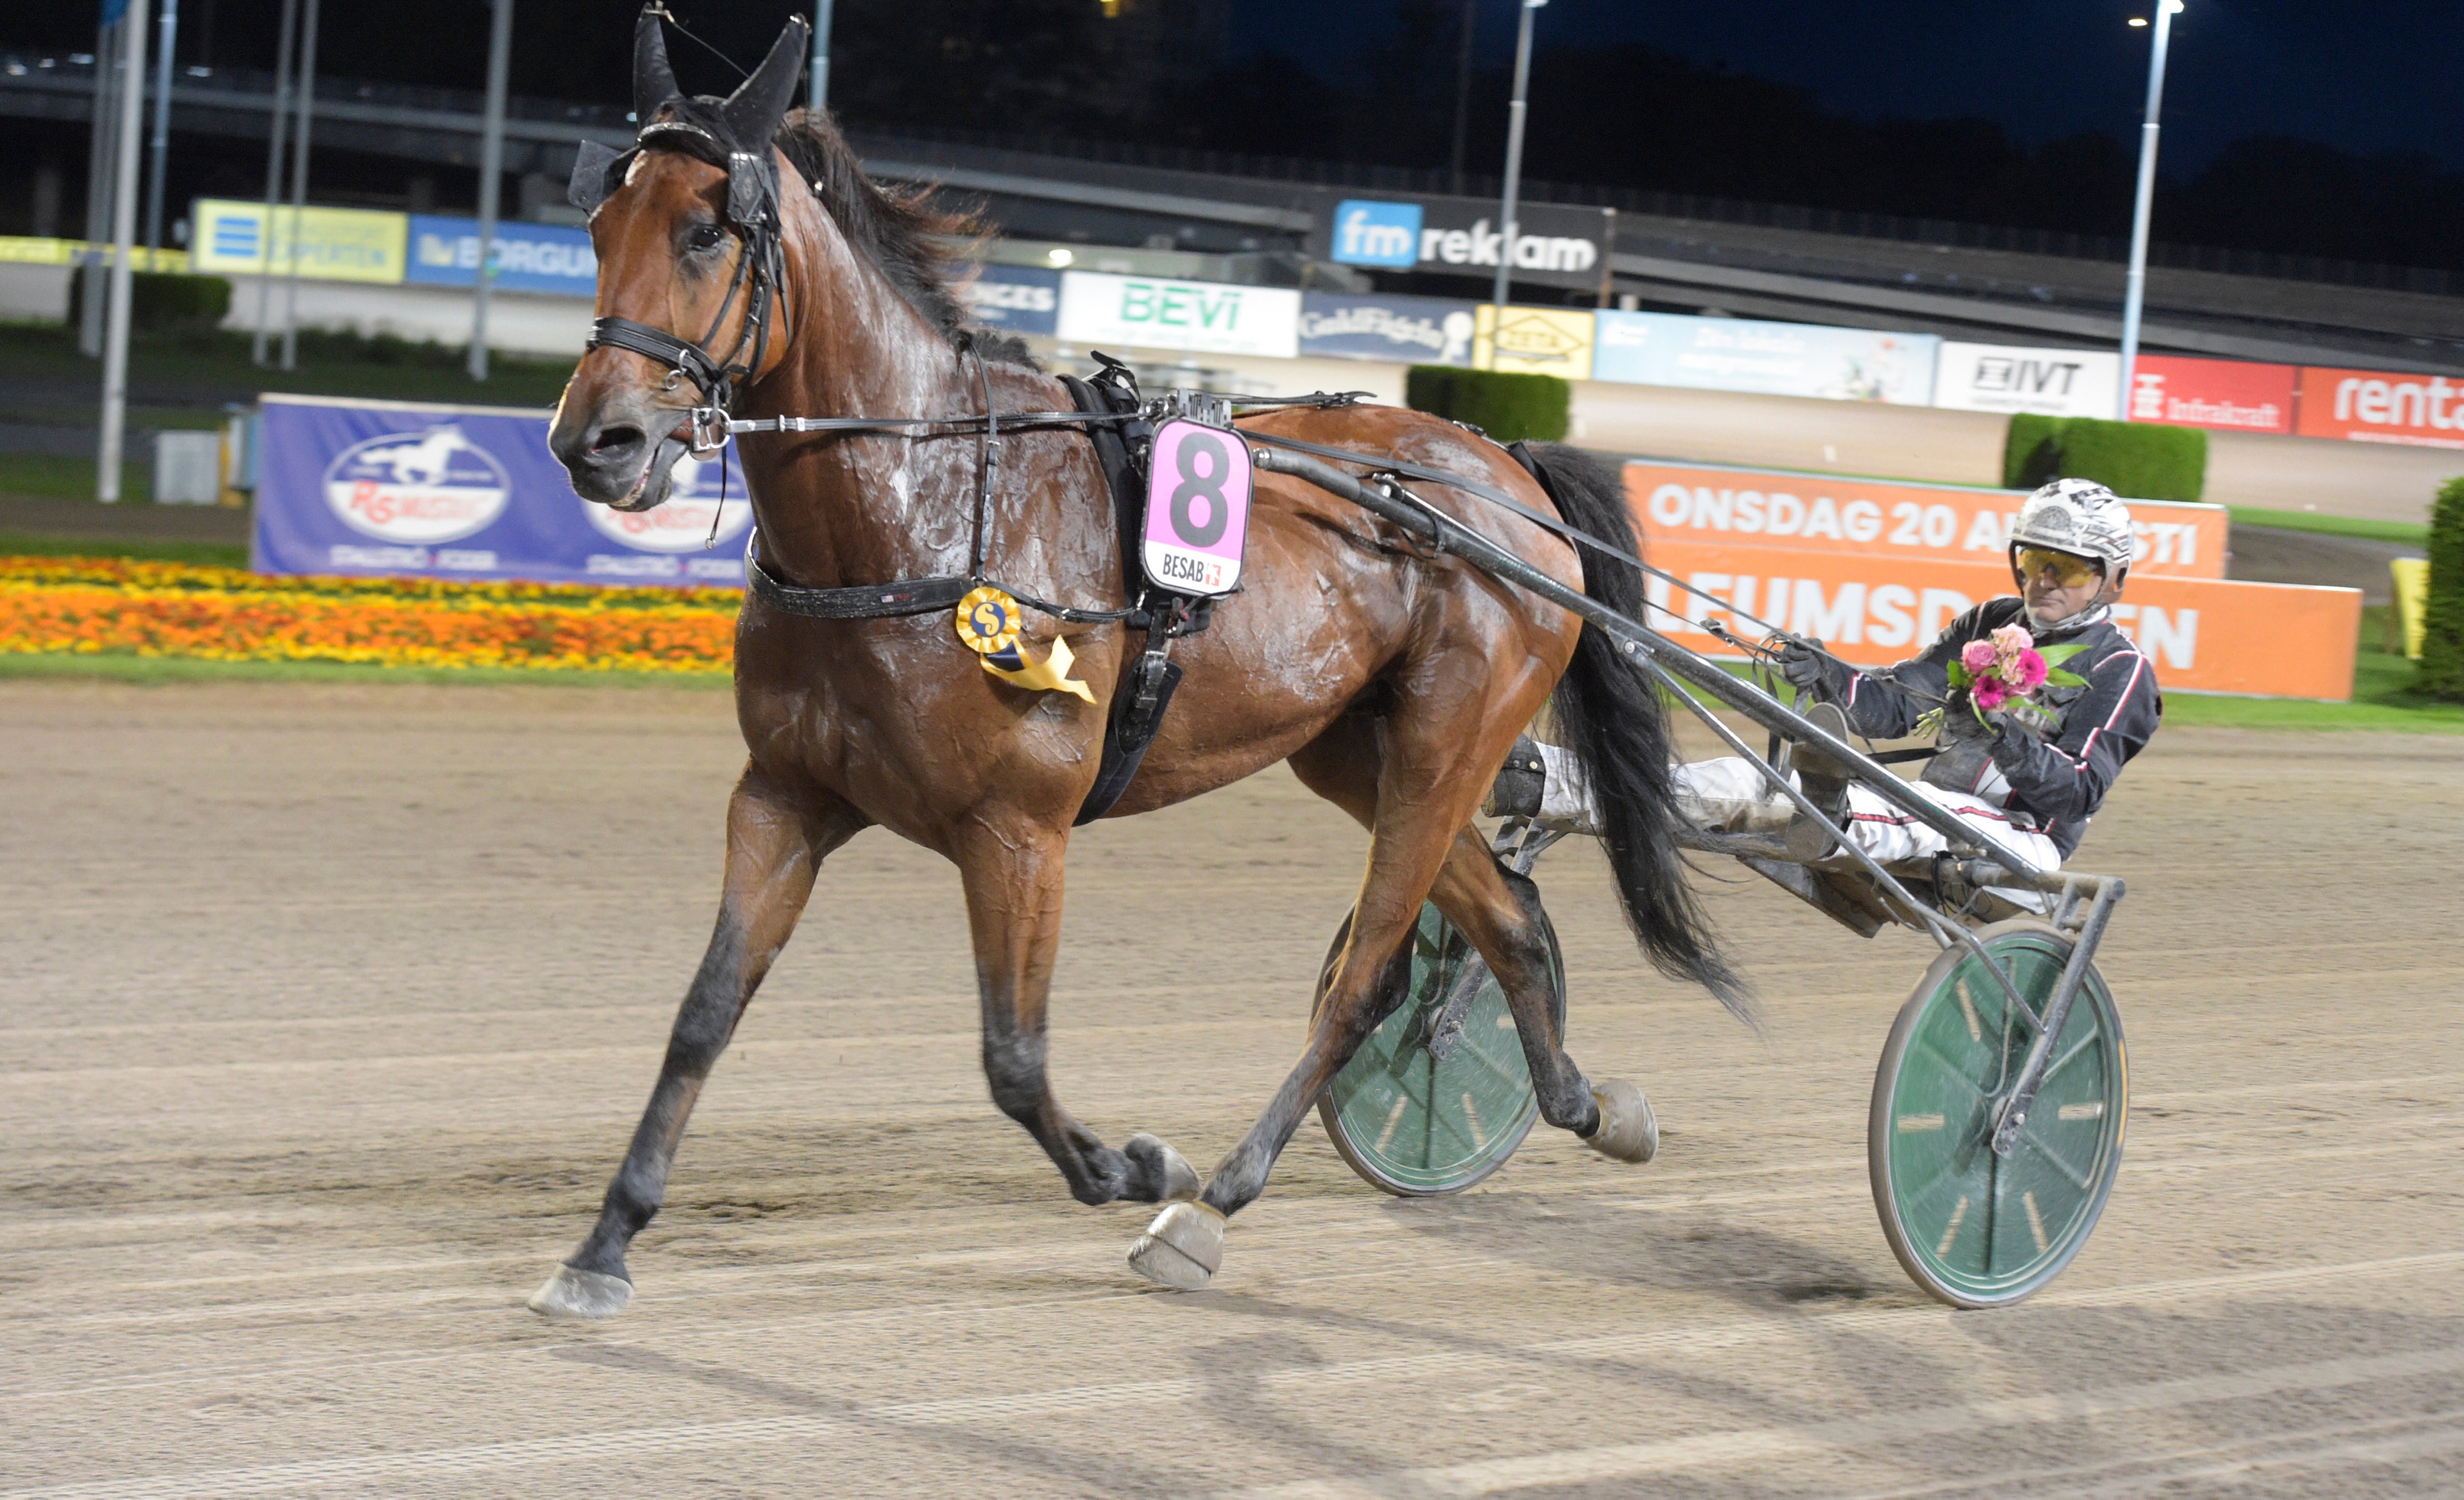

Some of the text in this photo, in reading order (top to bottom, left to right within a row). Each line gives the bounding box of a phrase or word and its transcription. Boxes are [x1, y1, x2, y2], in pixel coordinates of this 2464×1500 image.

[1342, 209, 1596, 273] fm reklam
[1169, 431, 1230, 548] 8
[1648, 483, 1884, 543] ONSDAG
[1887, 501, 1958, 549] 20
[1162, 553, 1204, 582] BESAB
